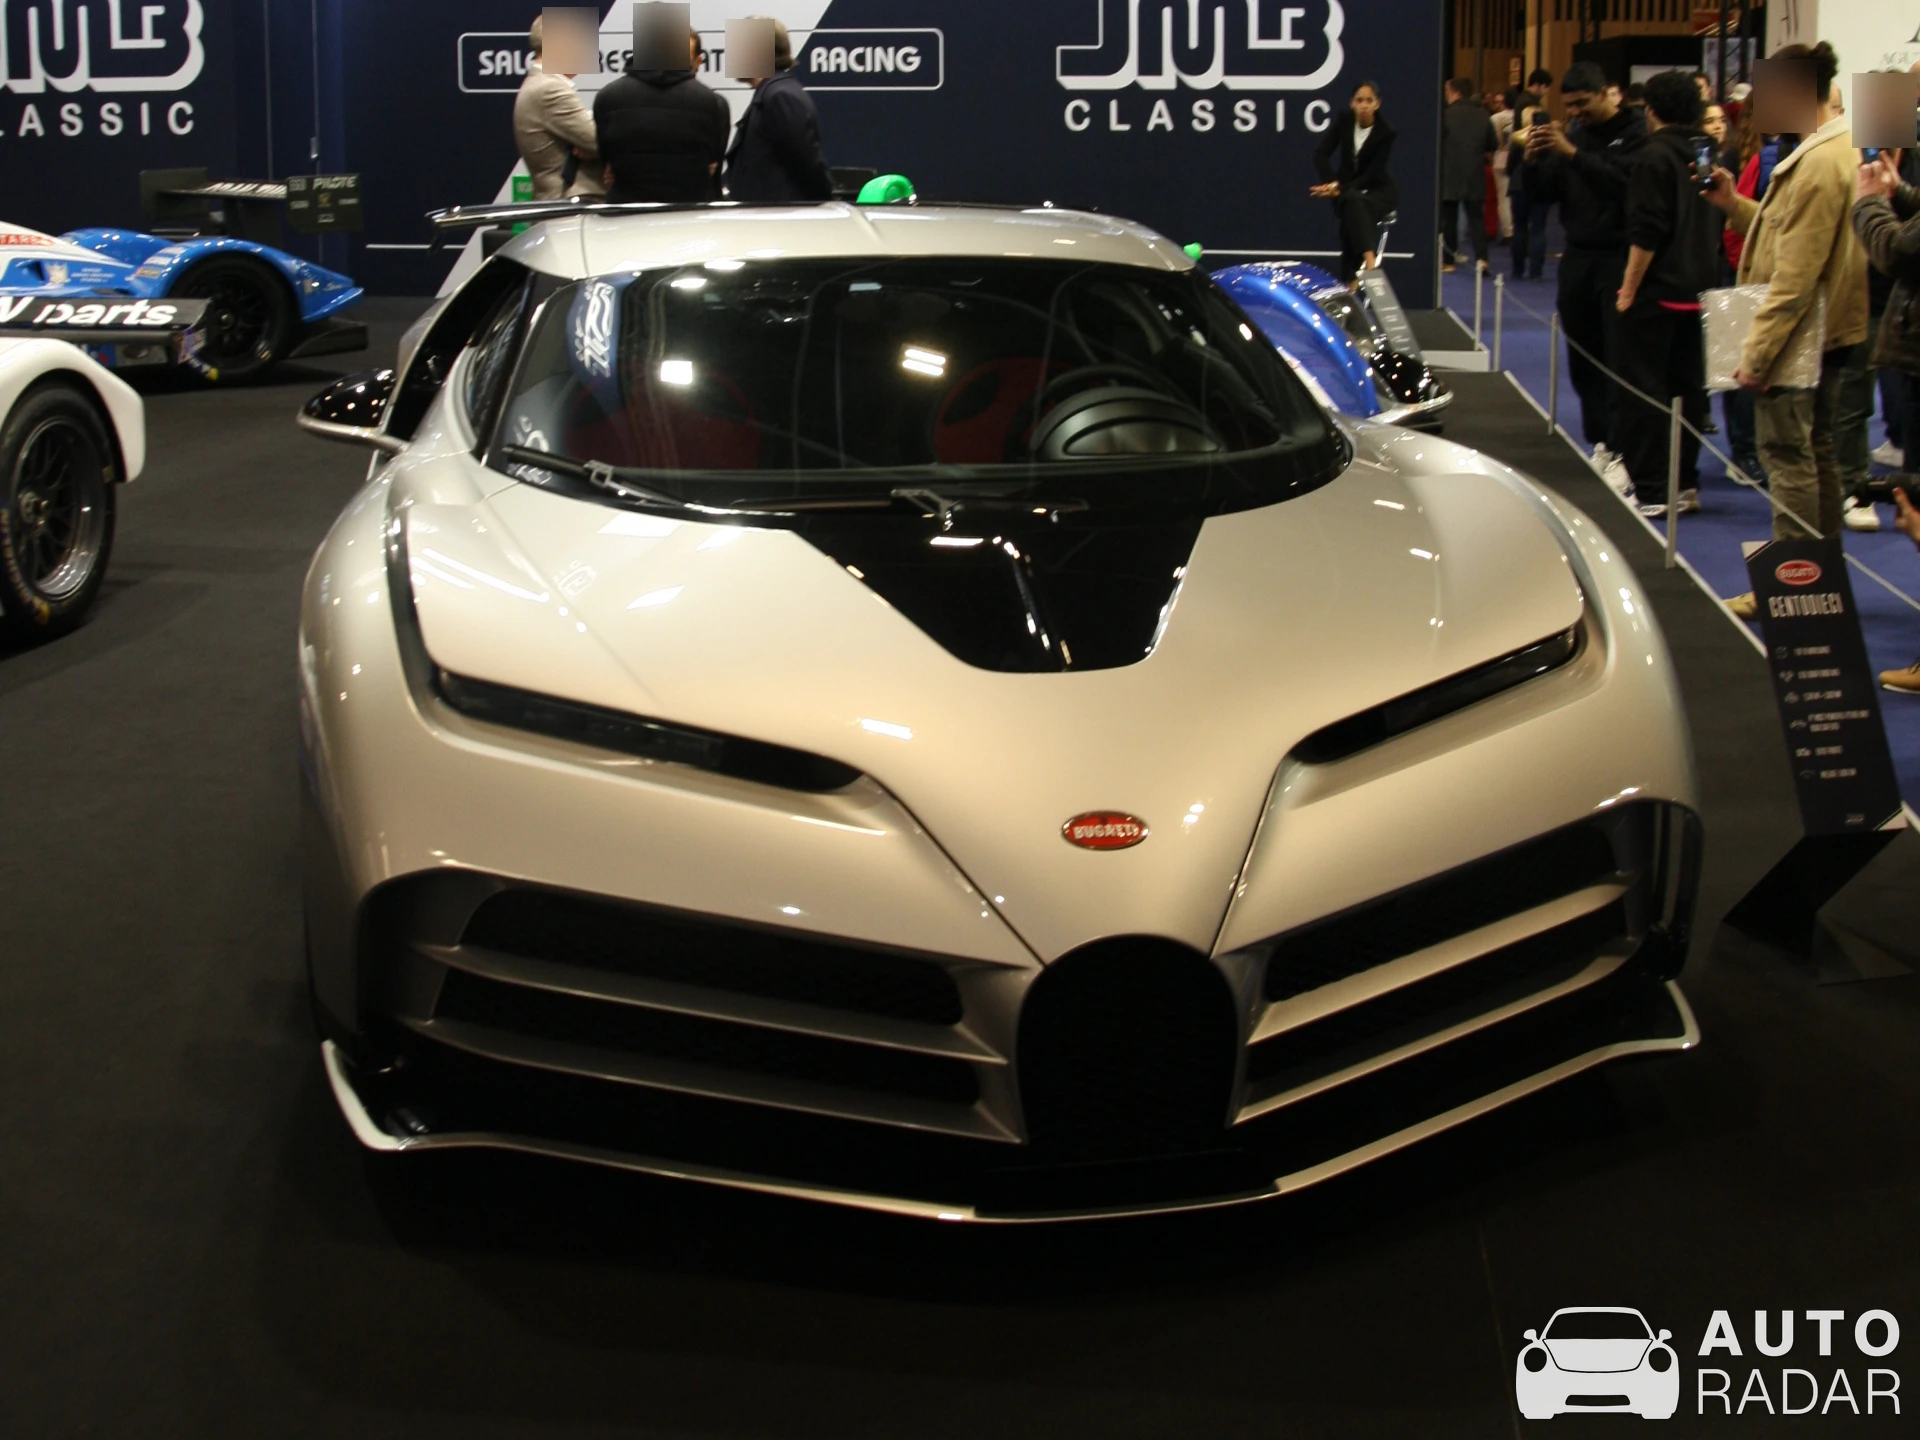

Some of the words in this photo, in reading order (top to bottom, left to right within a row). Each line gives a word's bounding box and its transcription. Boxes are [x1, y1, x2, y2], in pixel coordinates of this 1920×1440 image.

[1056, 0, 1345, 90] JMB
[479, 50, 536, 76] SALE
[810, 46, 922, 73] RACING
[0, 101, 194, 137] ASSIC
[1064, 99, 1331, 132] CLASSIC
[33, 299, 177, 326] parts
[1073, 823, 1139, 839] BUGATTI
